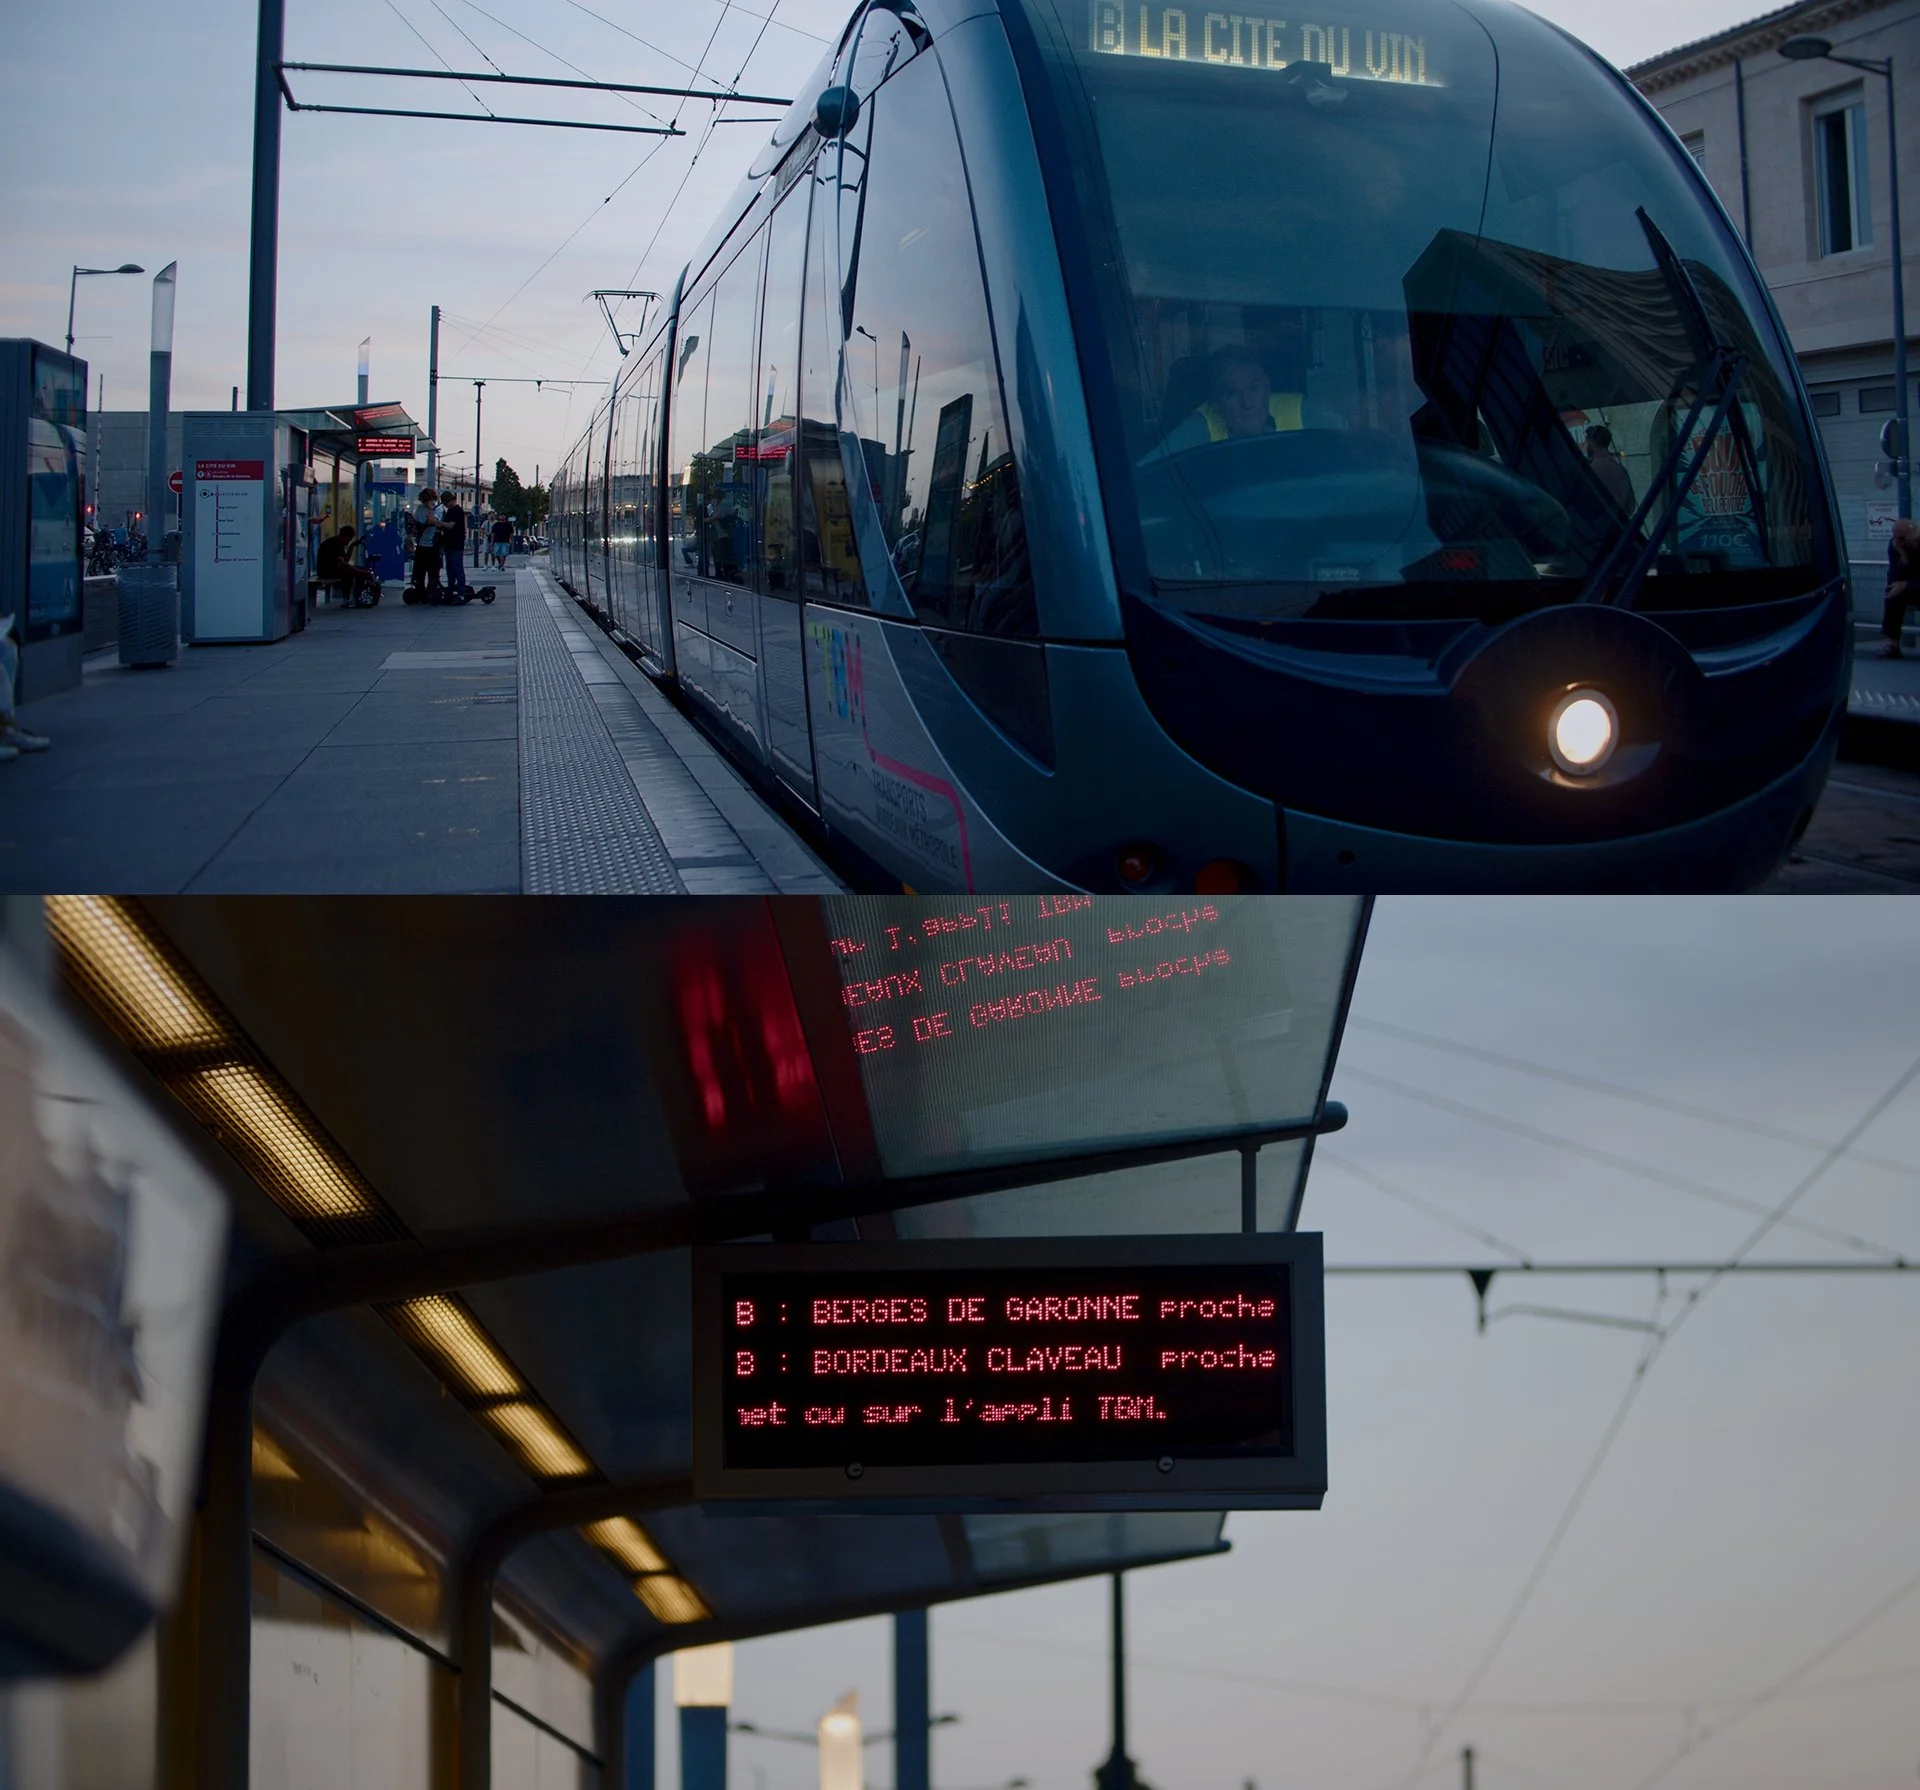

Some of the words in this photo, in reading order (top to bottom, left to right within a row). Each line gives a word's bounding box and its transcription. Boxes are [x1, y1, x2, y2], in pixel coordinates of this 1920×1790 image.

[1139, 5, 1186, 58] LA
[1204, 12, 1286, 69] CITE
[1301, 24, 1349, 76] DU
[1366, 30, 1424, 82] VIN
[1699, 533, 1751, 548] 110€
[872, 769, 927, 822] TRANSPORTS
[736, 1301, 754, 1326] B
[813, 1298, 928, 1324] BERGES
[948, 1297, 985, 1322] DE
[1006, 1295, 1141, 1321] GARONNE
[1160, 1294, 1276, 1319] proche
[736, 1351, 755, 1376] B
[814, 1348, 968, 1374] BORDEAUX
[987, 1345, 1121, 1372] CLAVEAU
[1160, 1343, 1277, 1369] proche
[863, 1405, 922, 1423] sur
[940, 1397, 1073, 1423] l'appli
[1098, 1396, 1167, 1420] TBM.
